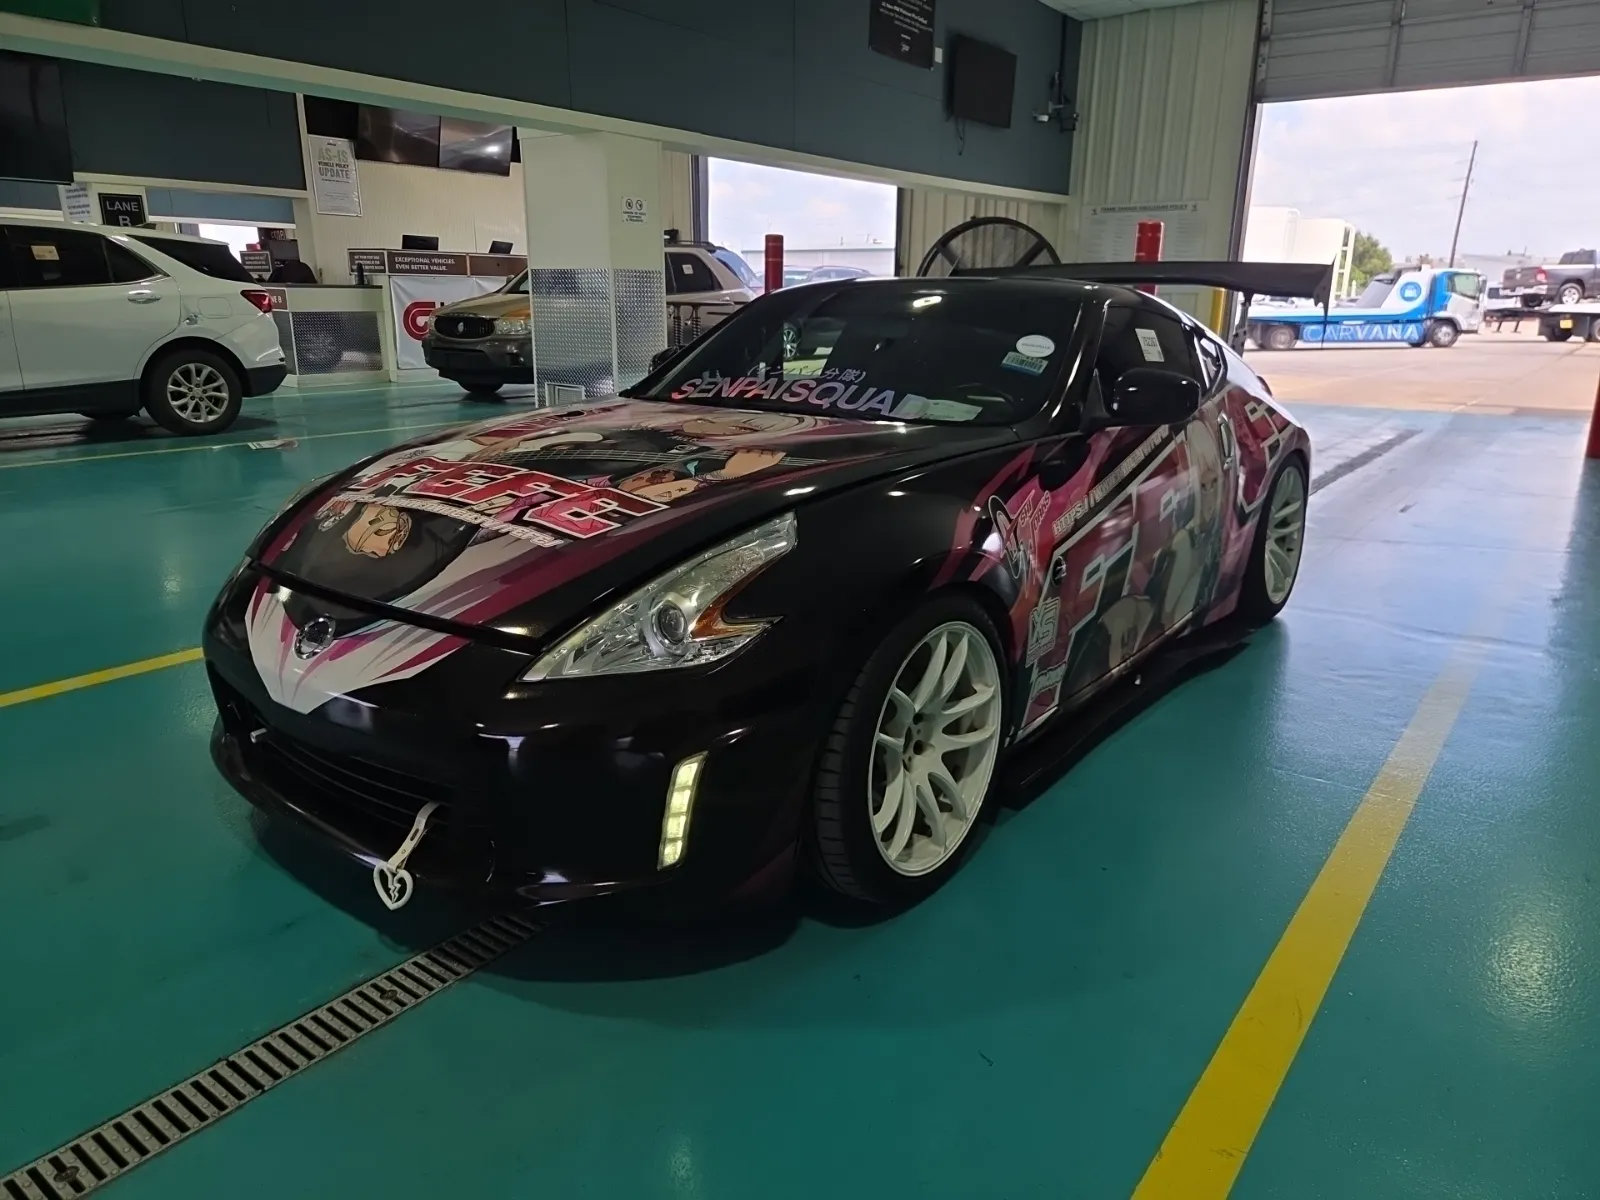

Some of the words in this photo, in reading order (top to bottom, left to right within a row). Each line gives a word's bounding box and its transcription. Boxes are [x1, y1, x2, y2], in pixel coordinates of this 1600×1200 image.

[319, 167, 350, 179] UPDATE
[106, 200, 140, 212] LANE
[1303, 323, 1419, 342] CARVANA
